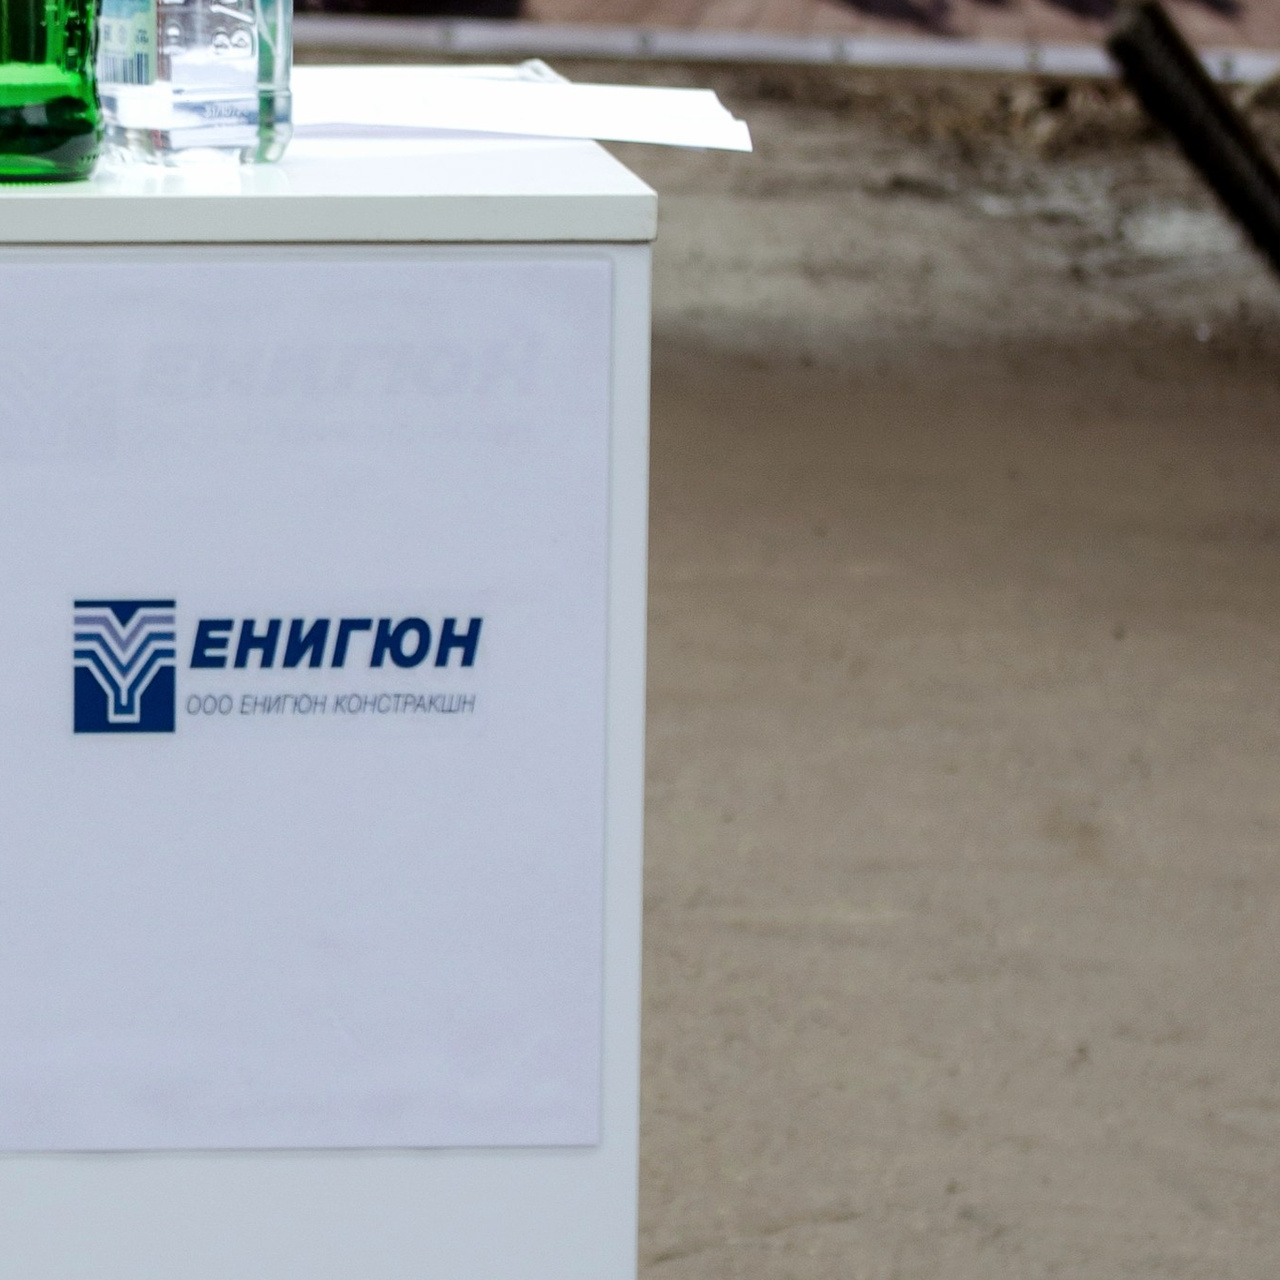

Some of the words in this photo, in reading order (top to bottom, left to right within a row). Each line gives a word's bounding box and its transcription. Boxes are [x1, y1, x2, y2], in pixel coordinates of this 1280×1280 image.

[189, 616, 484, 669] ЕНИГЮН
[186, 693, 234, 716] ООО
[240, 693, 328, 716] ЕНИГЮН
[331, 692, 476, 714] КОНСТРАКШН
